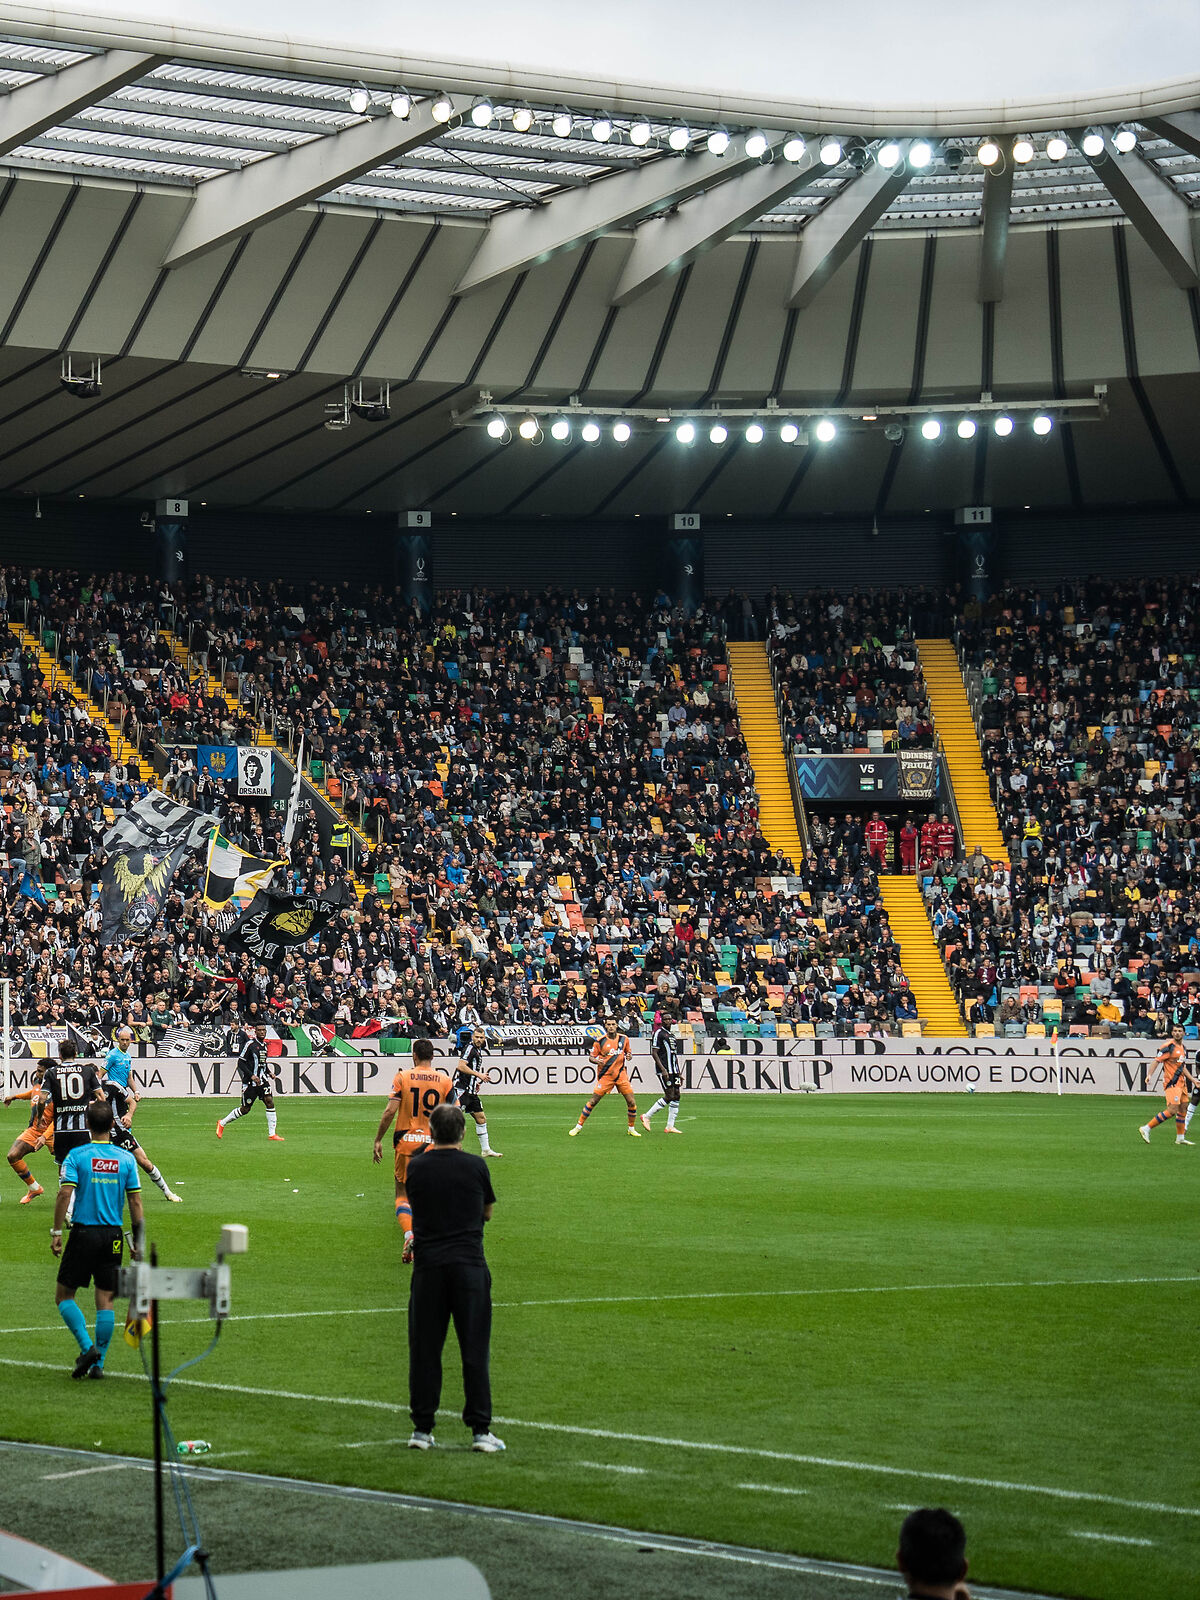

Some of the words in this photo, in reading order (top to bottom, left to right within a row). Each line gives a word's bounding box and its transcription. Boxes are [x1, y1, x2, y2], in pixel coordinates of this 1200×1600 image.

[173, 502, 181, 513] 8
[416, 514, 423, 525] 9
[971, 509, 985, 521] 11
[680, 515, 695, 527] 10
[257, 748, 269, 758] ZICO
[901, 751, 933, 760] UDINESE
[859, 764, 875, 774] V5
[901, 761, 933, 770] FRIULI
[239, 787, 268, 795] ORSARIA
[508, 1027, 532, 1036] AMIS
[532, 1026, 549, 1036] DAL
[517, 1036, 539, 1046] CLUB
[541, 1036, 585, 1046] TARCENTO
[56, 1066, 83, 1074] ZANIOLO
[480, 1066, 539, 1086] OMO
[547, 1066, 557, 1085] E
[564, 1065, 644, 1085] DOA
[850, 1065, 912, 1083] MODA
[917, 1065, 981, 1083] UOMO
[989, 1066, 1002, 1083] E
[1011, 1065, 1096, 1085] DONNA
[56, 1073, 84, 1101] 10
[263, 1086, 272, 1095] 27
[410, 1087, 441, 1118] 19
[56, 1104, 89, 1113] BLUENERGY
[92, 1160, 119, 1171] Lete
